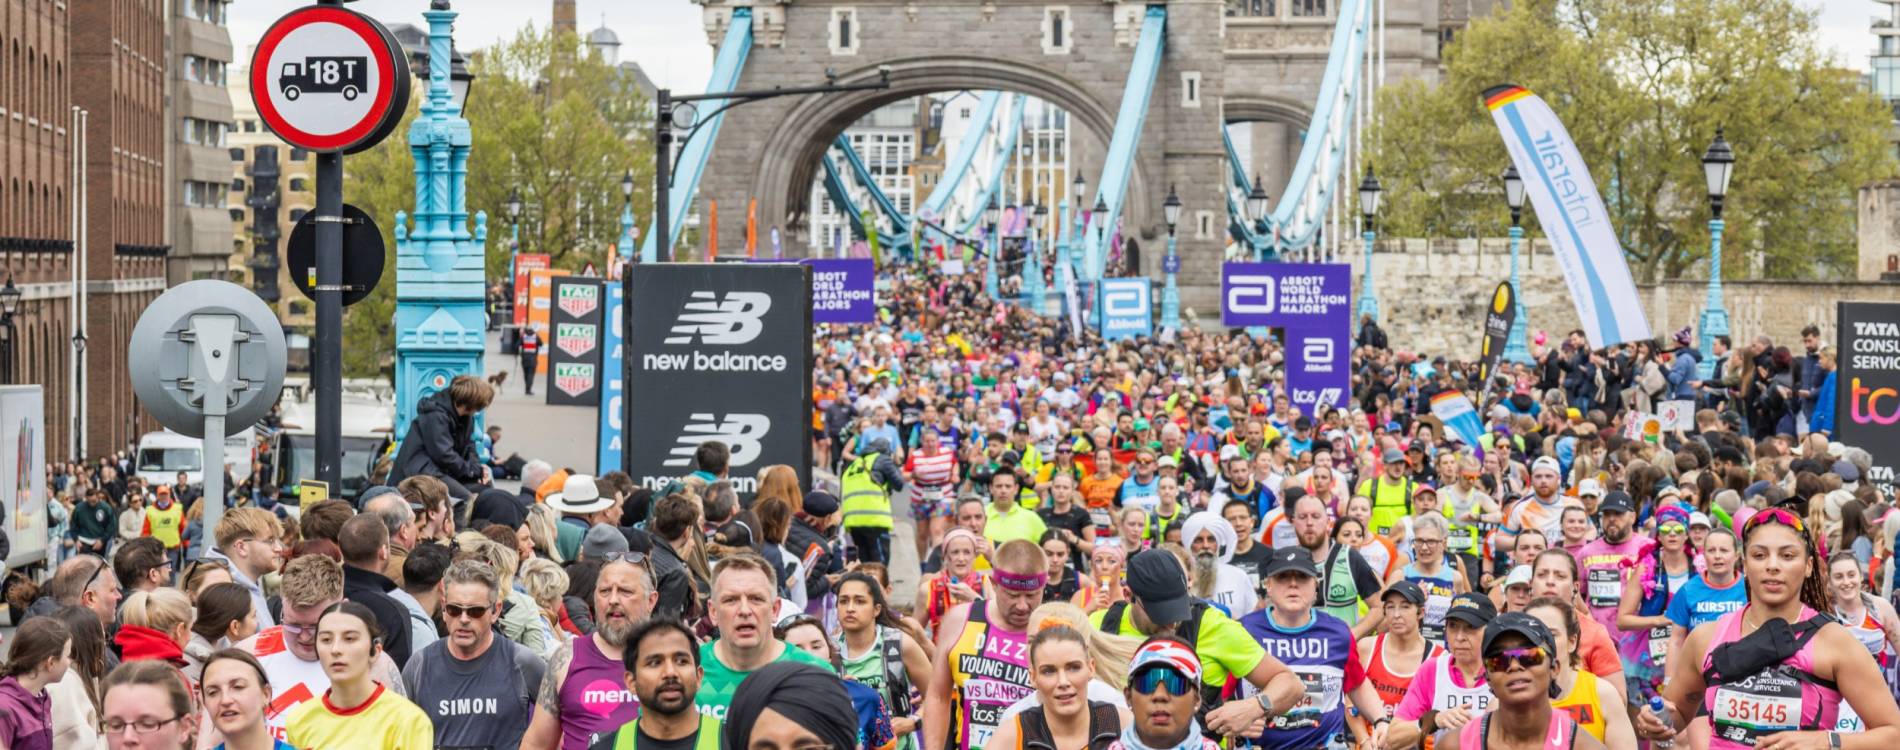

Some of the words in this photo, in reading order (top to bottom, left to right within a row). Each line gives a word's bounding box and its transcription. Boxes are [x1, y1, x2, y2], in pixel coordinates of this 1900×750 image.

[309, 60, 340, 85] 18
[343, 60, 358, 79] T
[813, 271, 848, 281] BBOTT
[1280, 276, 1325, 286] ABBOTT
[813, 281, 844, 291] ORLD
[1280, 285, 1321, 295] WORLD
[813, 290, 870, 300] ARATHON
[1280, 295, 1347, 304] MARATHON
[813, 300, 851, 310] AJORS
[1280, 304, 1328, 314] MAJORS
[1853, 322, 1900, 337] TATA
[643, 354, 689, 371] new
[694, 350, 788, 371] balance
[1293, 387, 1316, 403] tcs
[1851, 377, 1900, 424] tc
[1262, 638, 1329, 659] TRUDI
[961, 655, 1003, 678] YOUNG
[439, 698, 497, 716] SIMON
[1728, 698, 1787, 723] 35145
